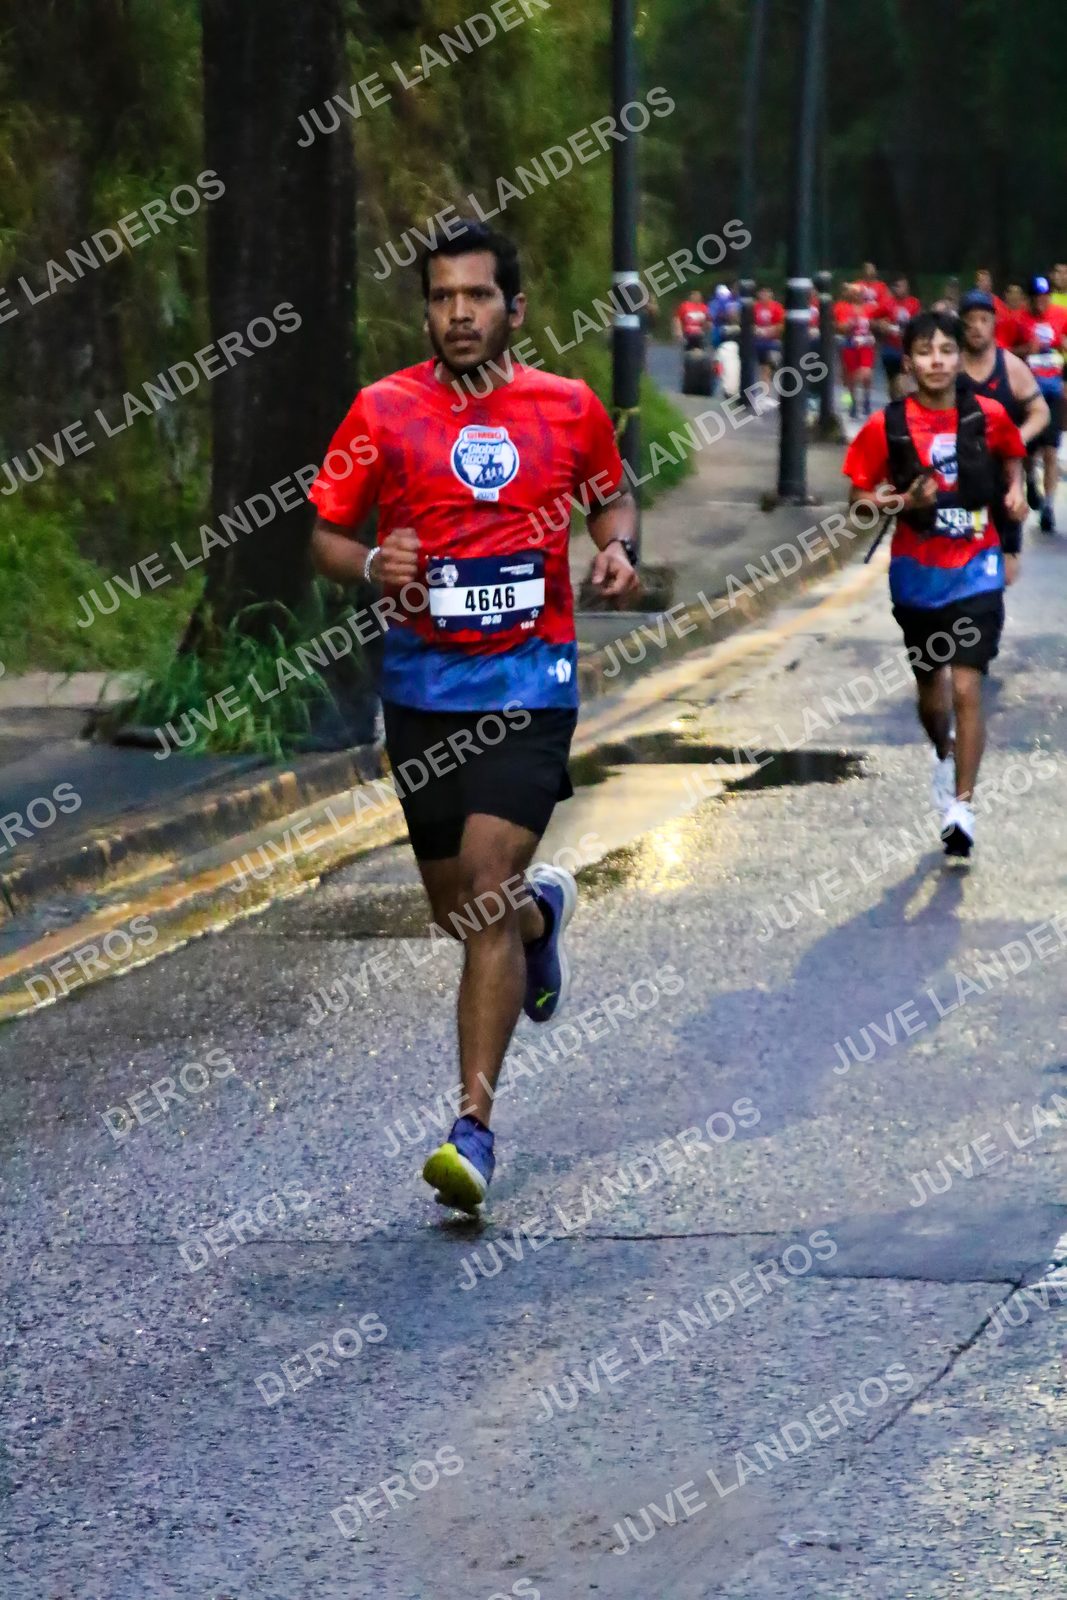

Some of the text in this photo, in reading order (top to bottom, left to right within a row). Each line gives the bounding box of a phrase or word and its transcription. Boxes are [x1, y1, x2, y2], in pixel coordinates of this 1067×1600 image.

[468, 443, 502, 455] Global
[461, 453, 489, 465] Race
[464, 586, 516, 612] 4646
